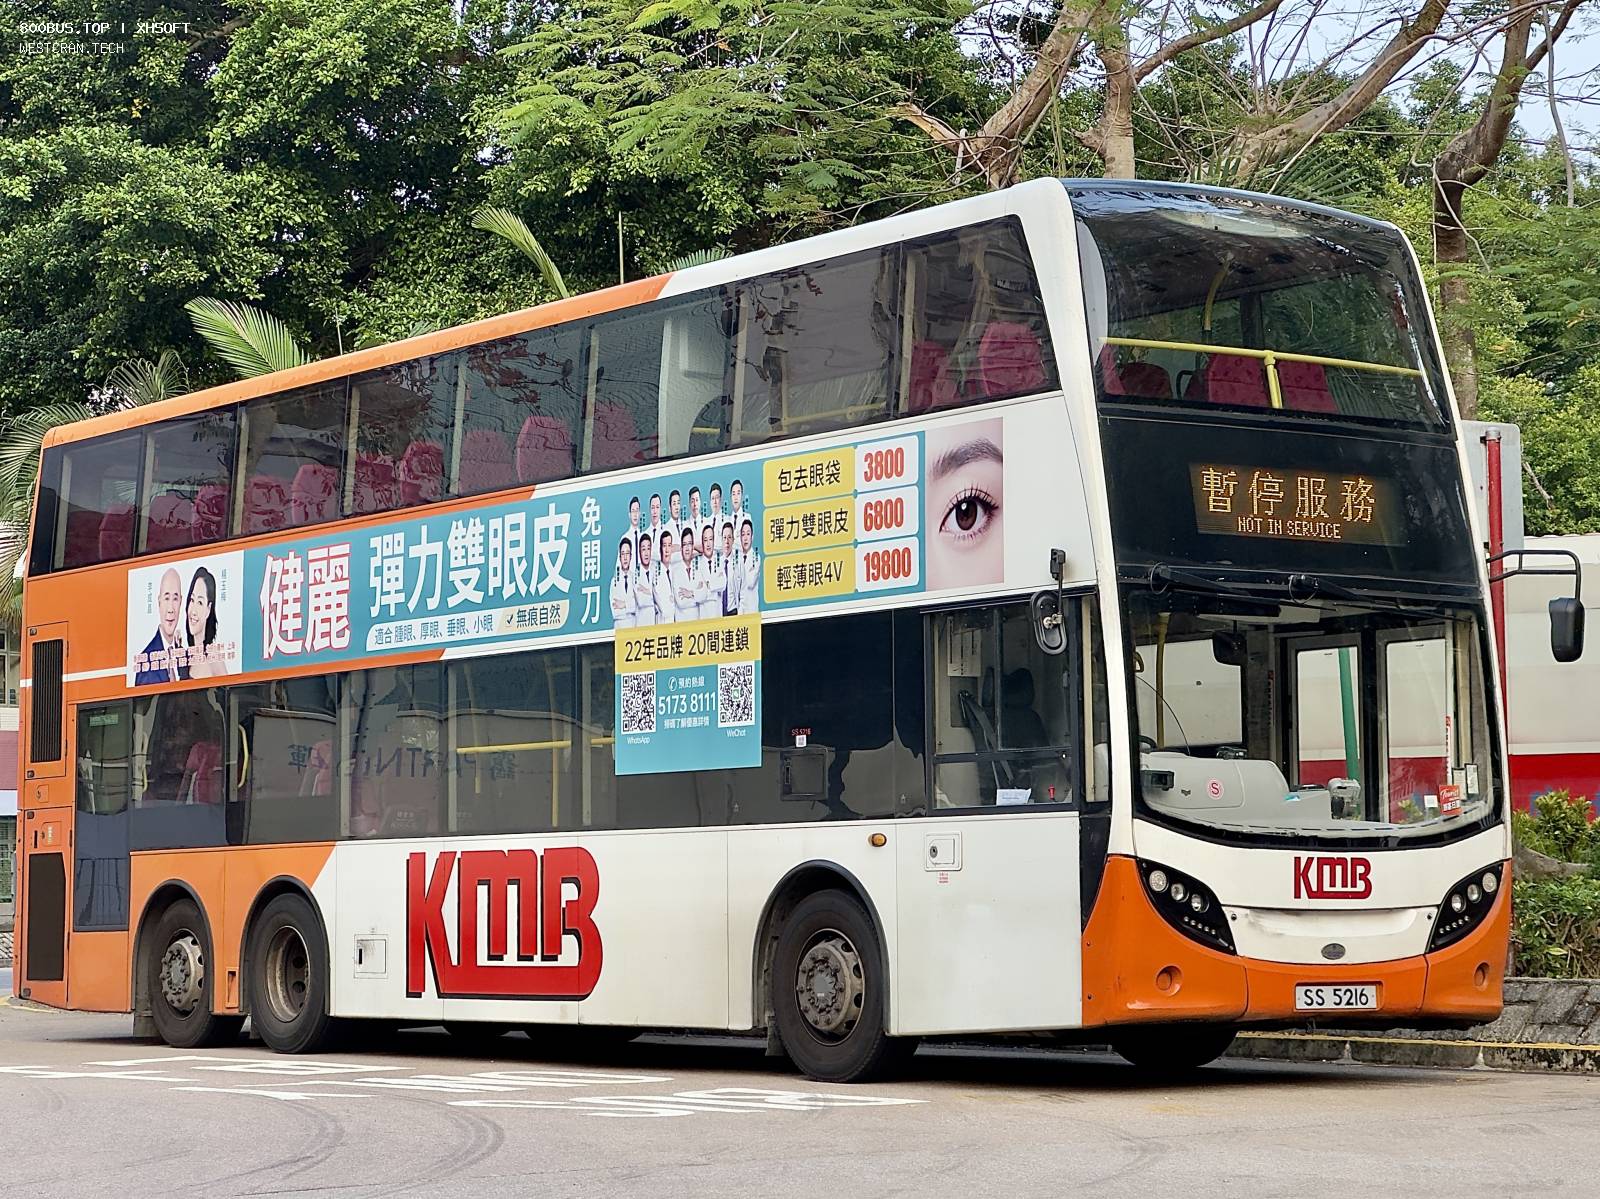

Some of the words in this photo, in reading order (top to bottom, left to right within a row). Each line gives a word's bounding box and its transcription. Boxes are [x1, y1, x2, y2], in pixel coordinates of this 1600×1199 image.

[777, 459, 841, 493] 包去眼袋
[863, 446, 905, 483] 3800
[1201, 467, 1376, 523] 暫停服務
[769, 507, 849, 543] 彈力雙眼皮
[863, 497, 904, 532] 6800
[1237, 516, 1263, 534] NOT
[1267, 518, 1283, 535] IN
[1286, 520, 1342, 539] SERVICE
[369, 502, 572, 618] 彈力雙眼皮
[580, 496, 602, 625] 免開刀
[776, 560, 844, 592] 輕薄眼4V
[863, 546, 912, 583] 19800
[259, 542, 351, 660] 健麗
[516, 605, 561, 629] 無痕自然
[624, 633, 684, 663] 22年品牌
[688, 626, 750, 656] 20間連鎖
[658, 694, 687, 715] 5173
[690, 692, 716, 712] 8111
[1293, 856, 1373, 900] KMB
[406, 846, 604, 1002] KMB
[1303, 988, 1326, 1007] SS
[1333, 987, 1369, 1006] 5216
[168, 1070, 676, 1100] ONLY
[445, 1087, 933, 1119] BUS
